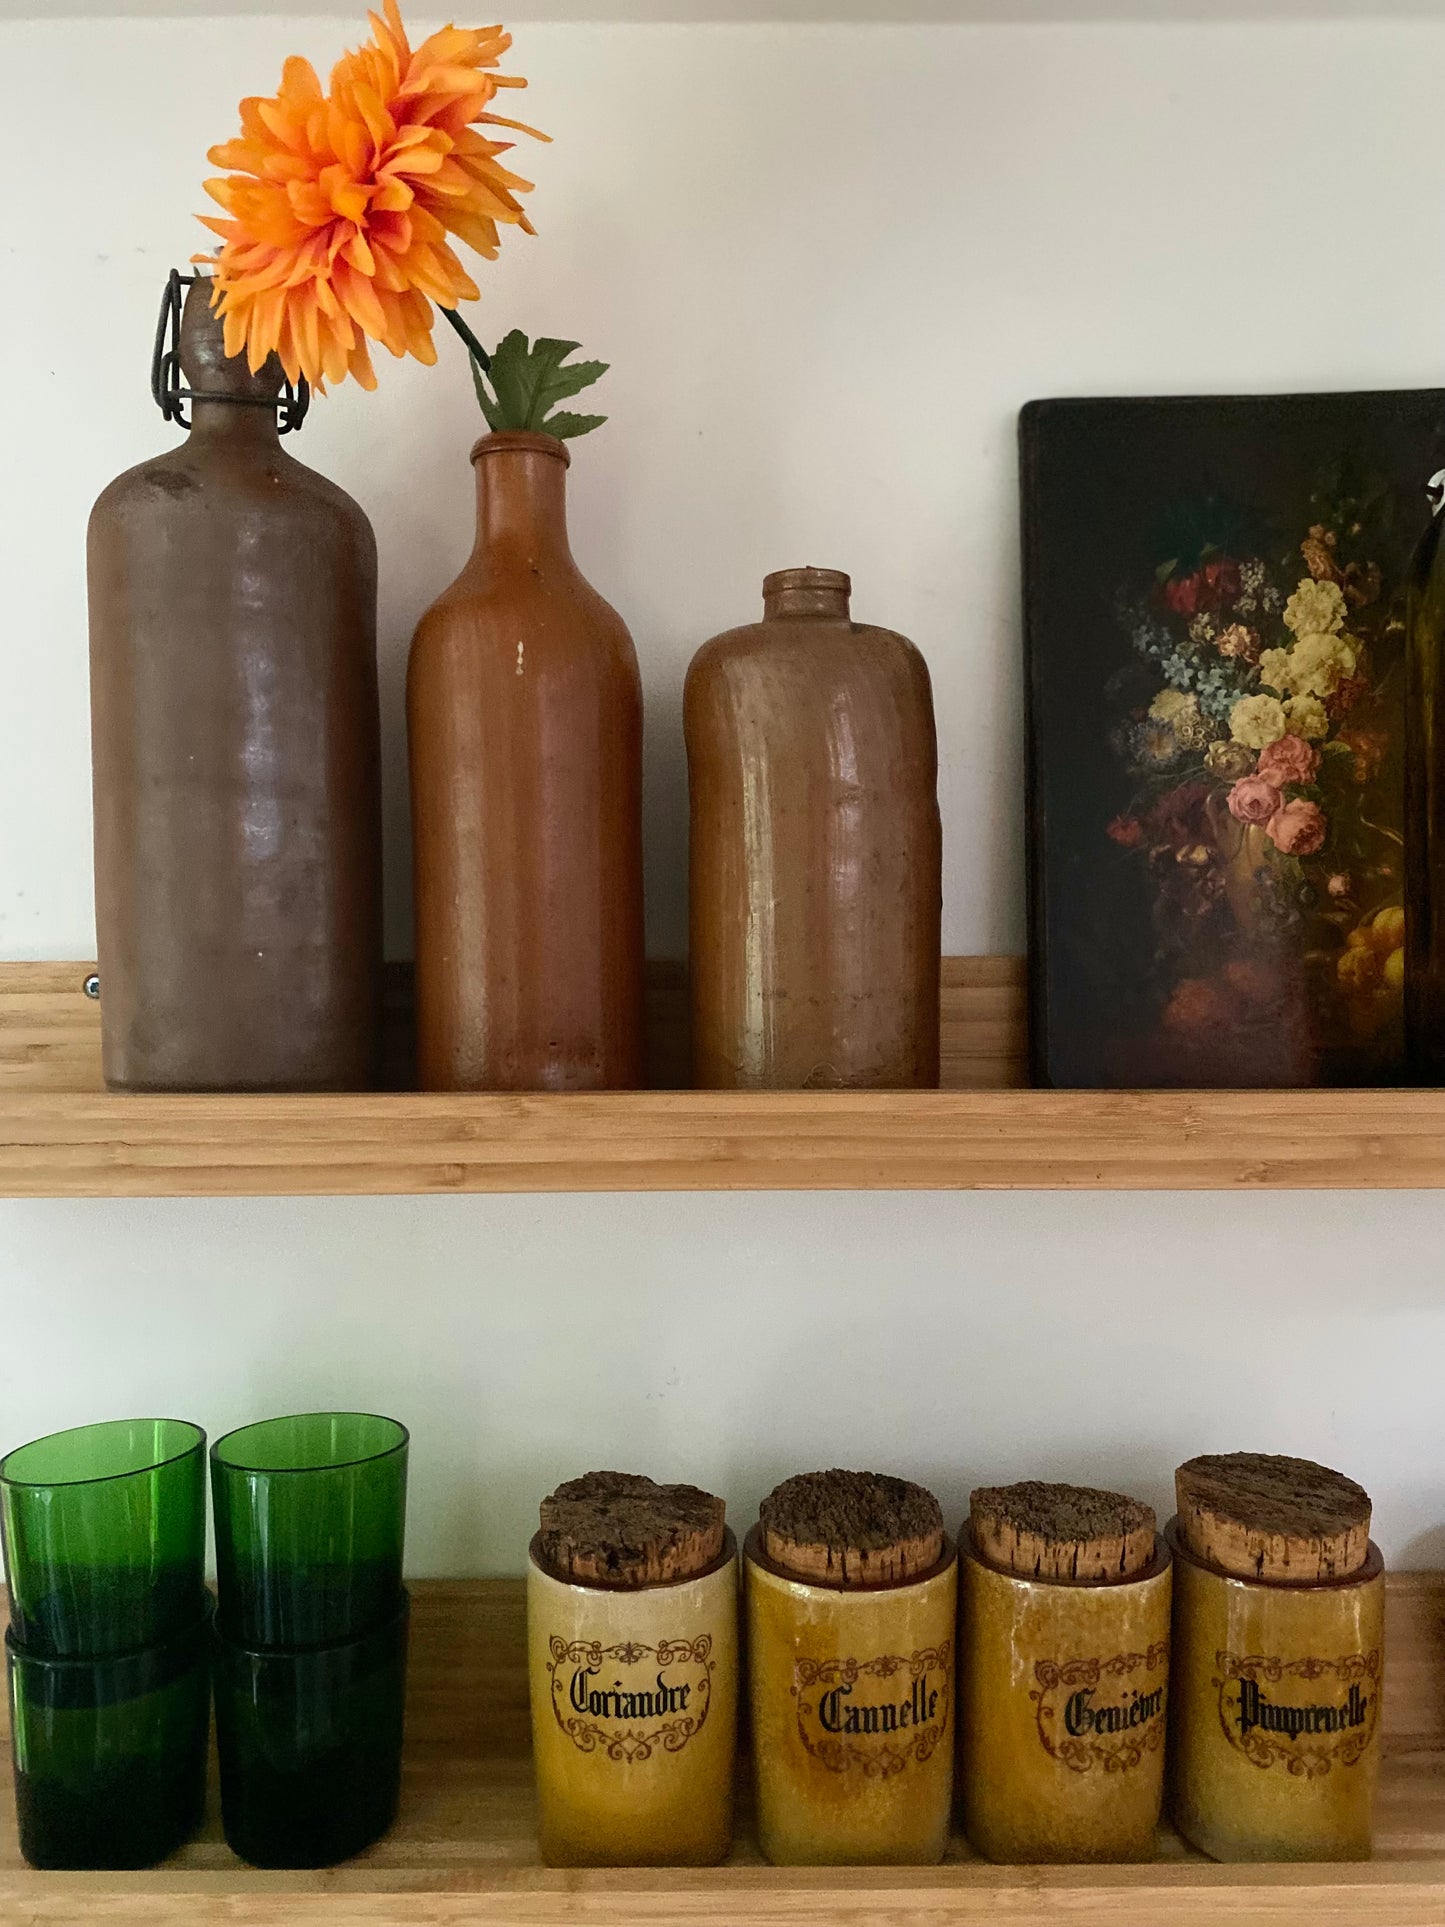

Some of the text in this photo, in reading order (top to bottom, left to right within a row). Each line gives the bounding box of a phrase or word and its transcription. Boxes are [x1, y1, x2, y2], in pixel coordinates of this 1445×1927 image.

[570, 1665, 691, 1719] Coriandre
[819, 1672, 938, 1733] Cannelle
[1236, 1677, 1367, 1741] Pimprenelle
